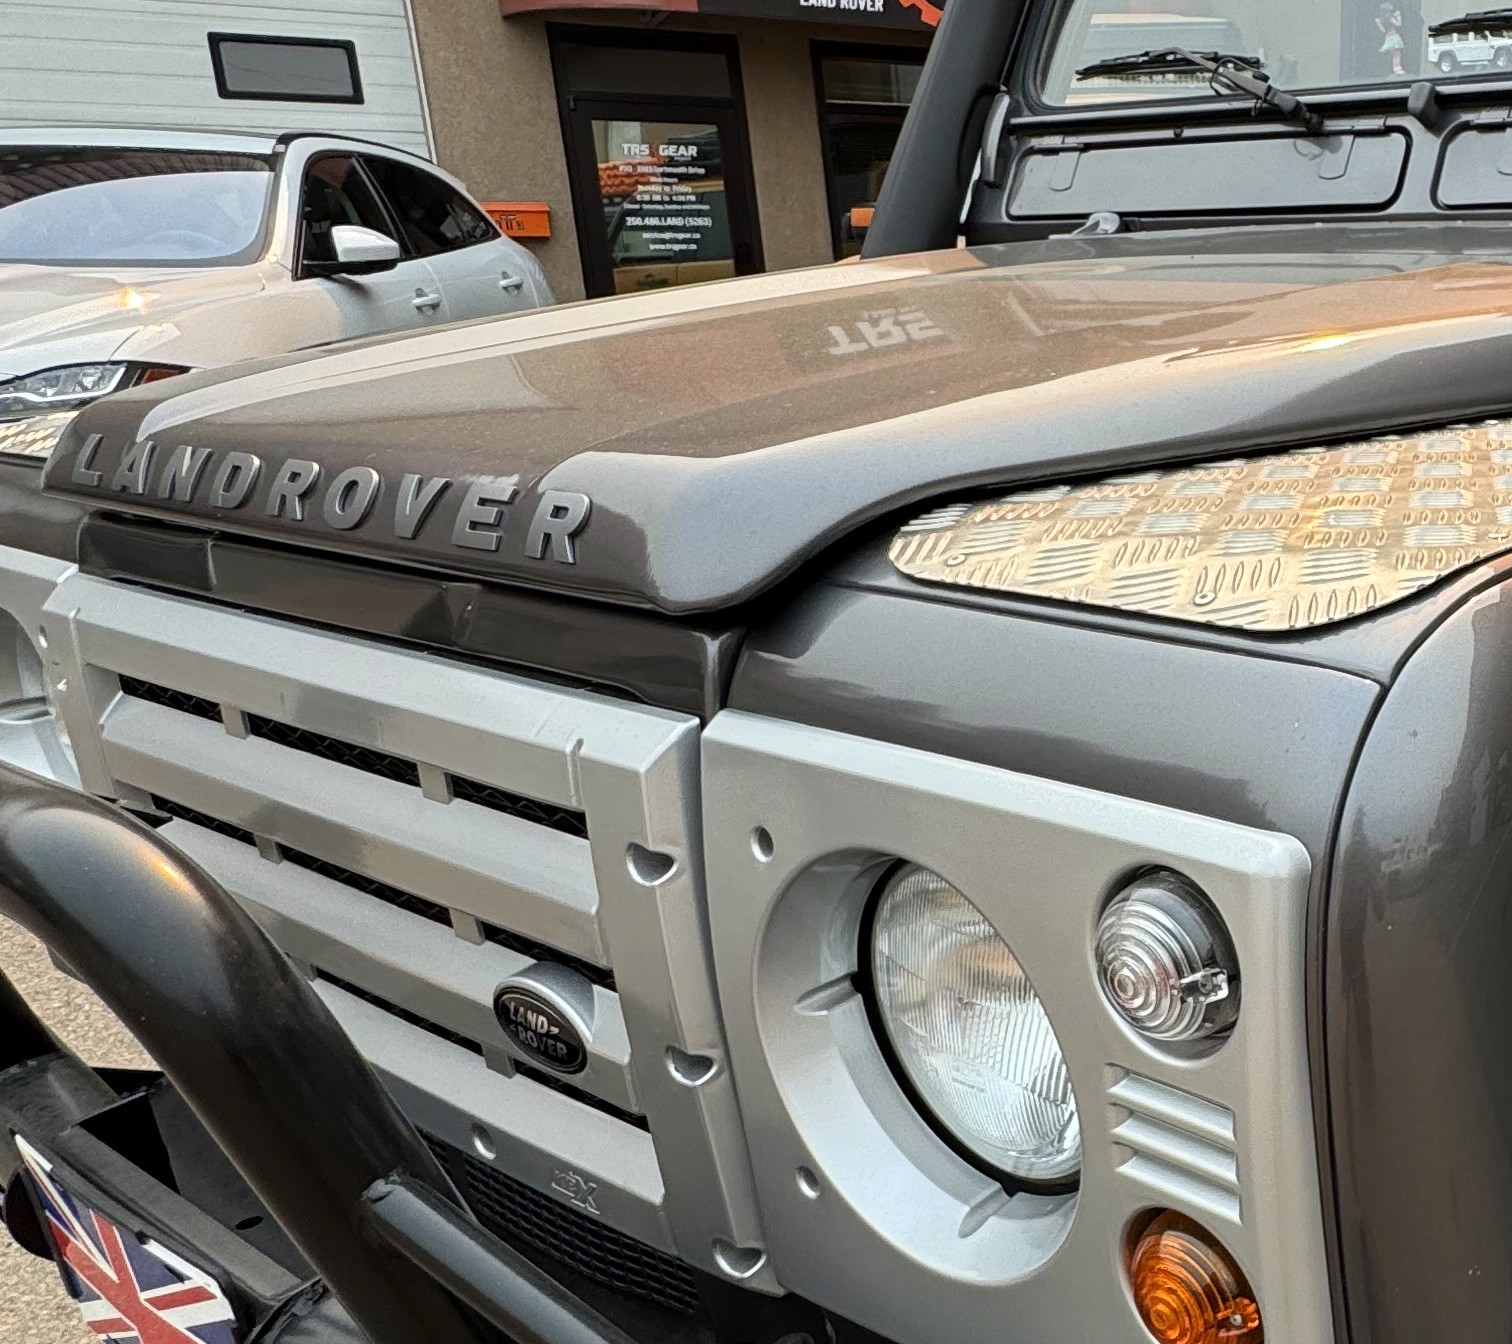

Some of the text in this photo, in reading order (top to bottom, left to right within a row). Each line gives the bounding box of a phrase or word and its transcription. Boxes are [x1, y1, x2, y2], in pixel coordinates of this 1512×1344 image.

[622, 143, 698, 157] TRS GEAR
[509, 1001, 549, 1034] LAND
[517, 1025, 568, 1061] ROVER
